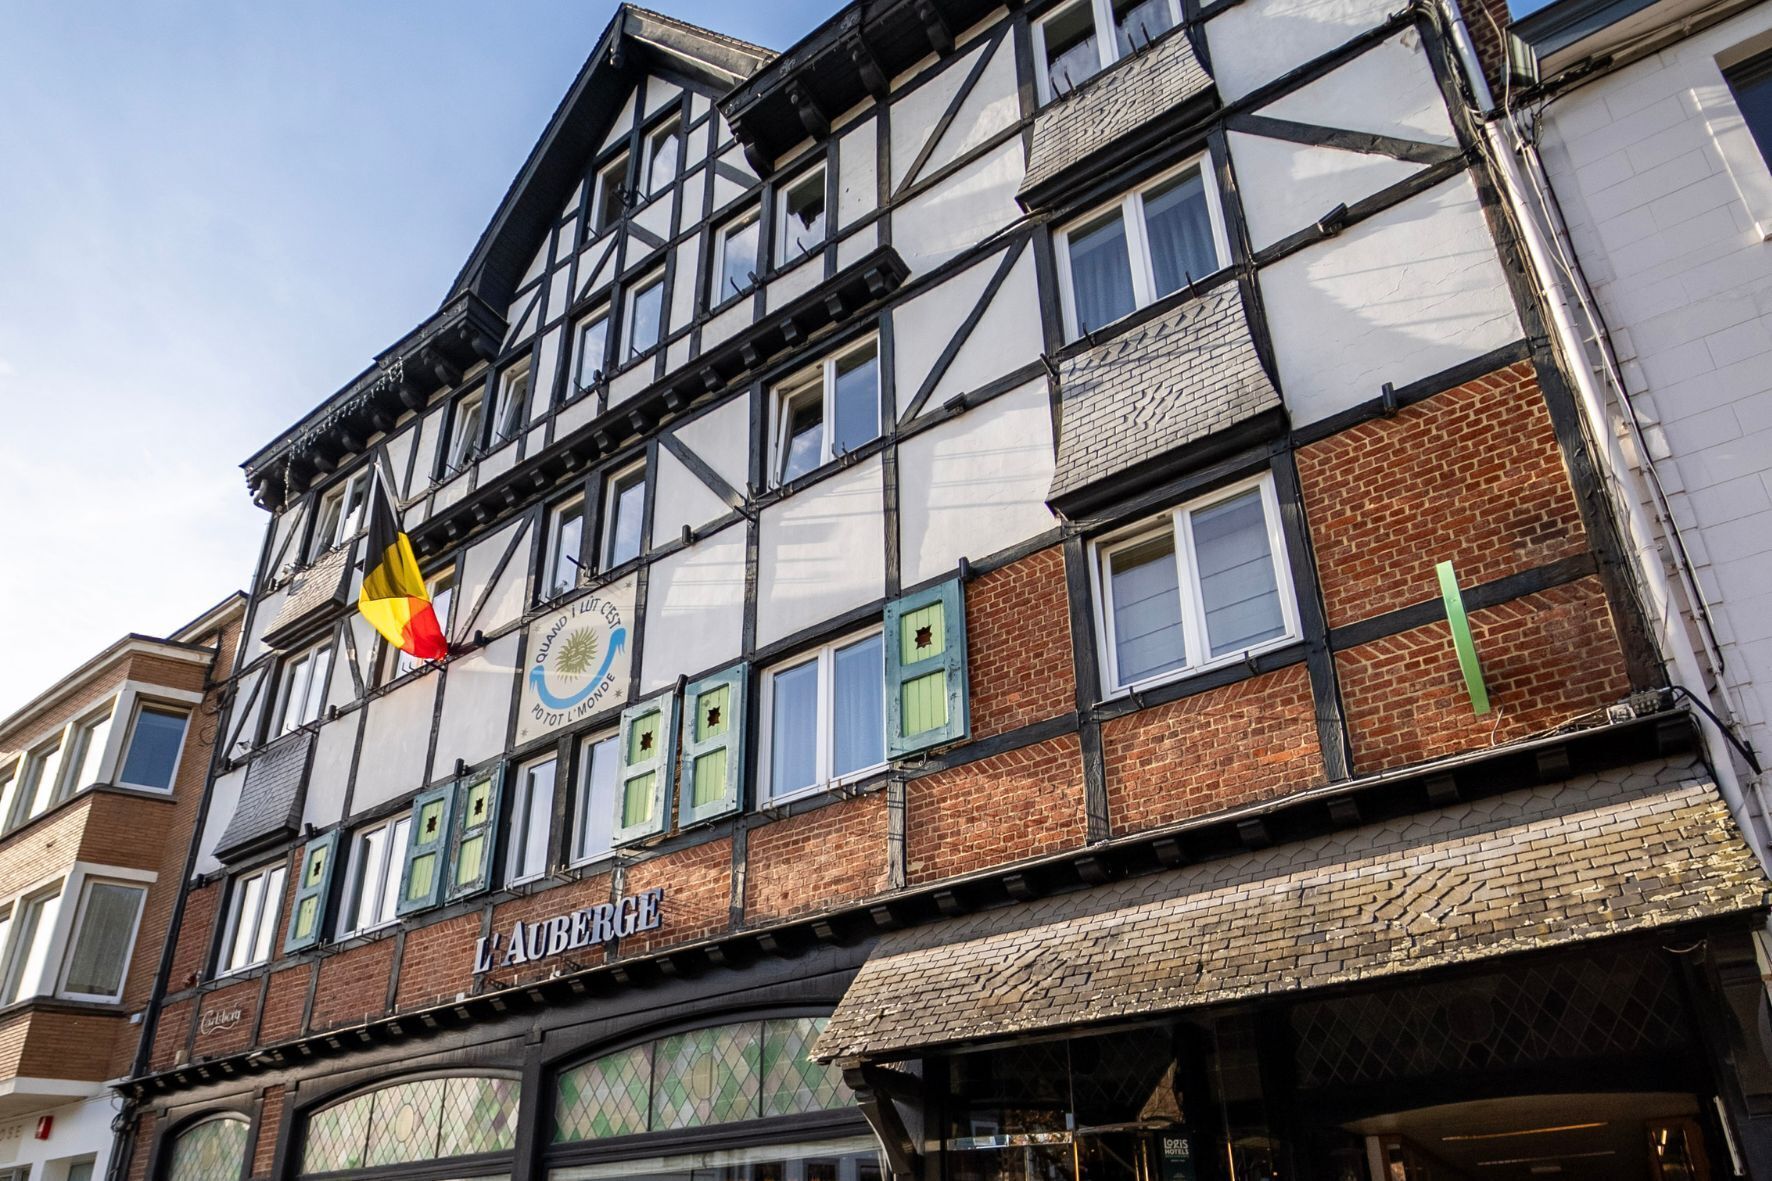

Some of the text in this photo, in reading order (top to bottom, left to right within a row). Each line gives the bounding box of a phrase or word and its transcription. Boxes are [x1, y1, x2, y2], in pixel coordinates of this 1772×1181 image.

[536, 615, 567, 663] QUAND
[600, 601, 621, 629] C'EST
[543, 711, 564, 726] TOT
[472, 888, 664, 975] L'AUBERGE
